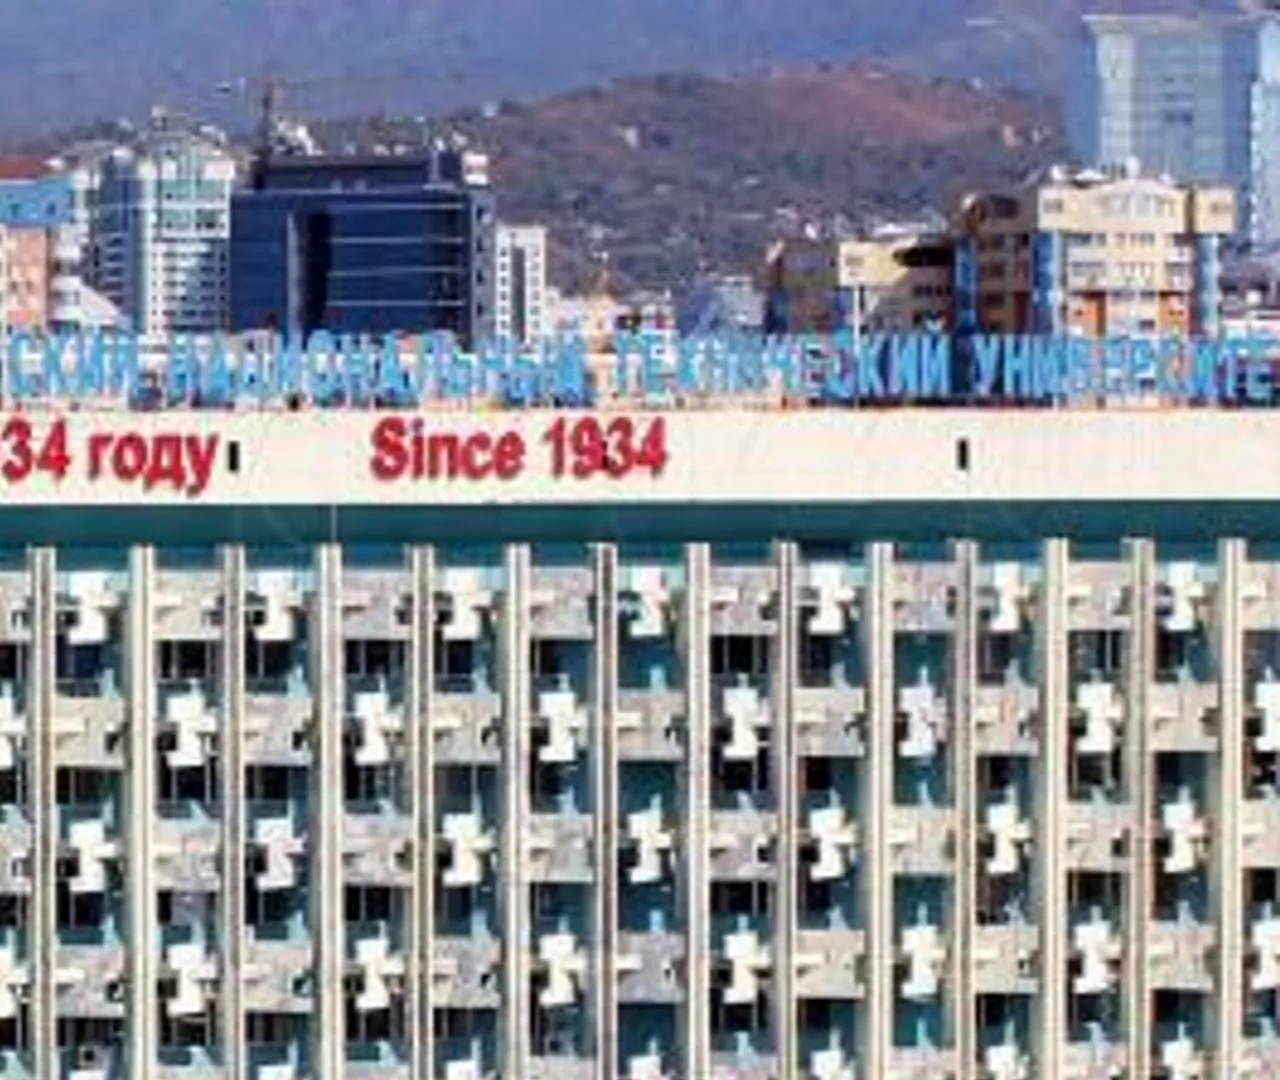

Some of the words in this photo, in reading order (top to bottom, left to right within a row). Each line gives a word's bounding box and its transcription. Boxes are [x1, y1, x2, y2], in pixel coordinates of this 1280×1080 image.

[89, 433, 220, 496] году
[370, 416, 527, 480] Since
[543, 416, 670, 478] 1934
